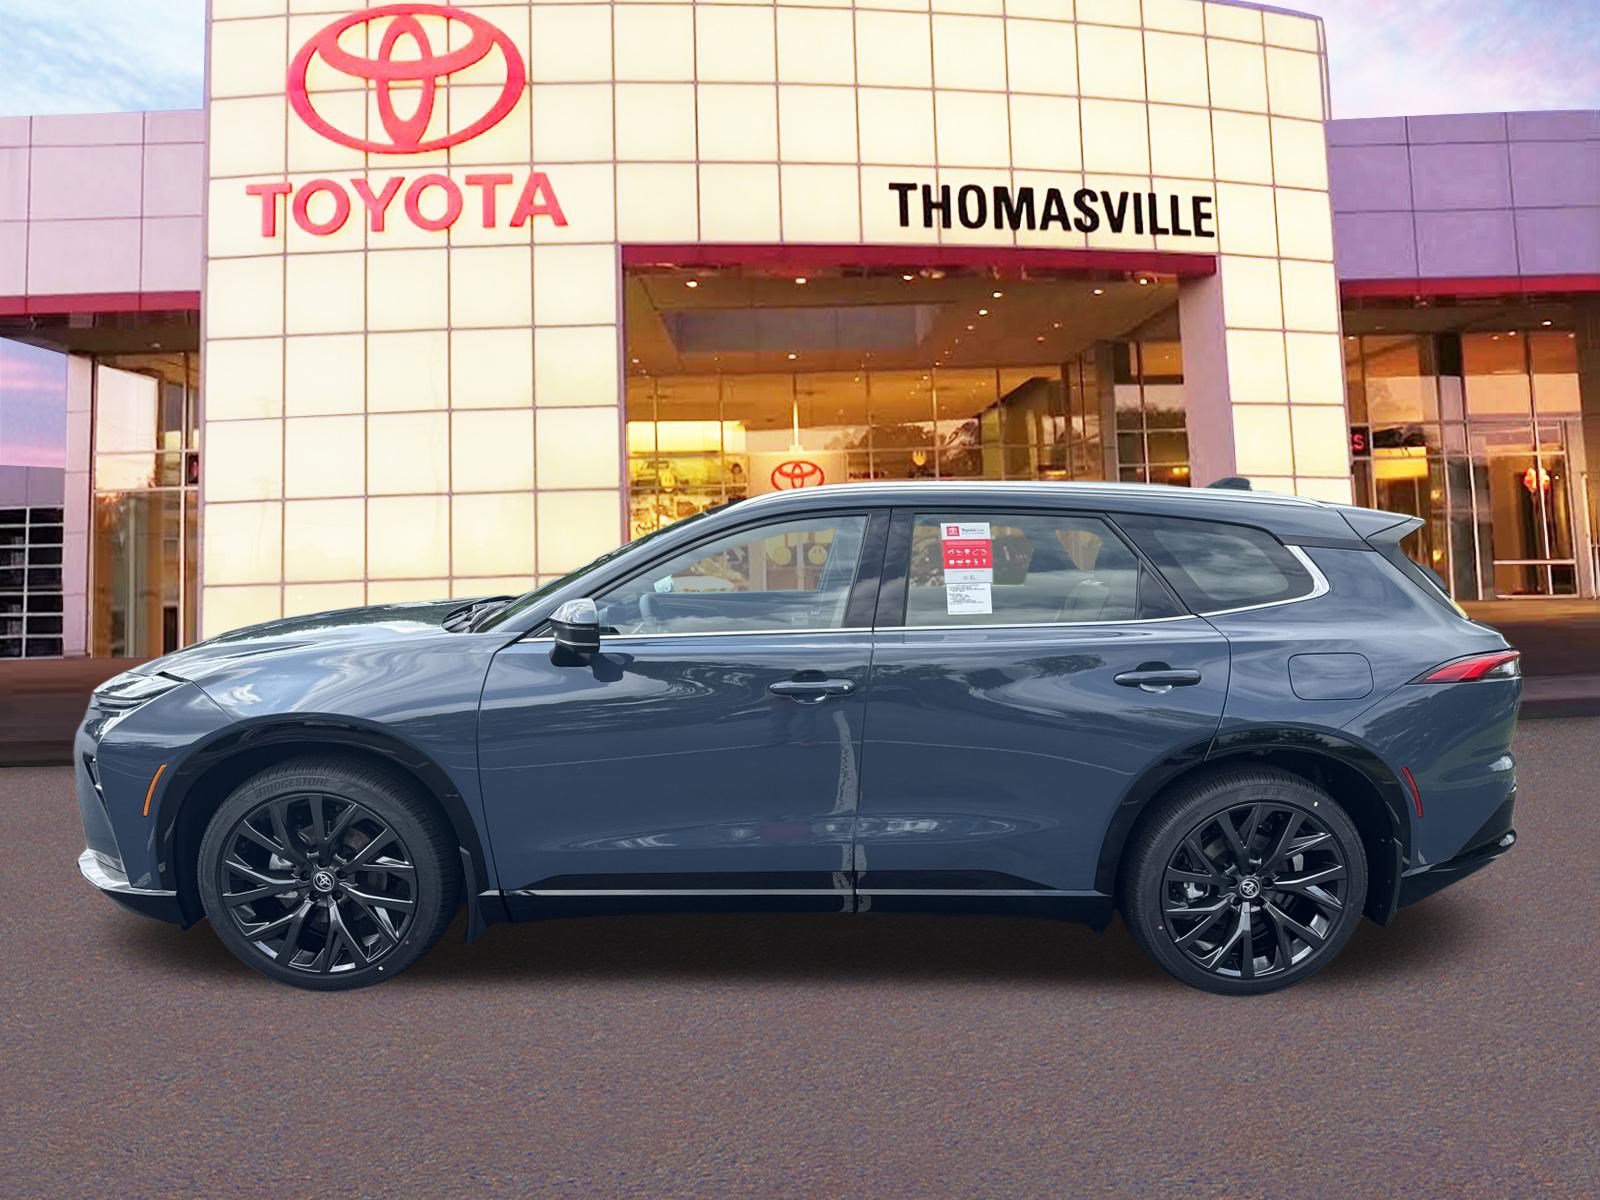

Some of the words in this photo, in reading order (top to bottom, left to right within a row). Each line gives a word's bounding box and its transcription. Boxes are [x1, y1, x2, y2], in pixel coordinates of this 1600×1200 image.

[246, 172, 568, 238] TOYOTA
[889, 182, 1215, 237] THOMASVILLE
[255, 777, 329, 799] BRIDGESTONE
